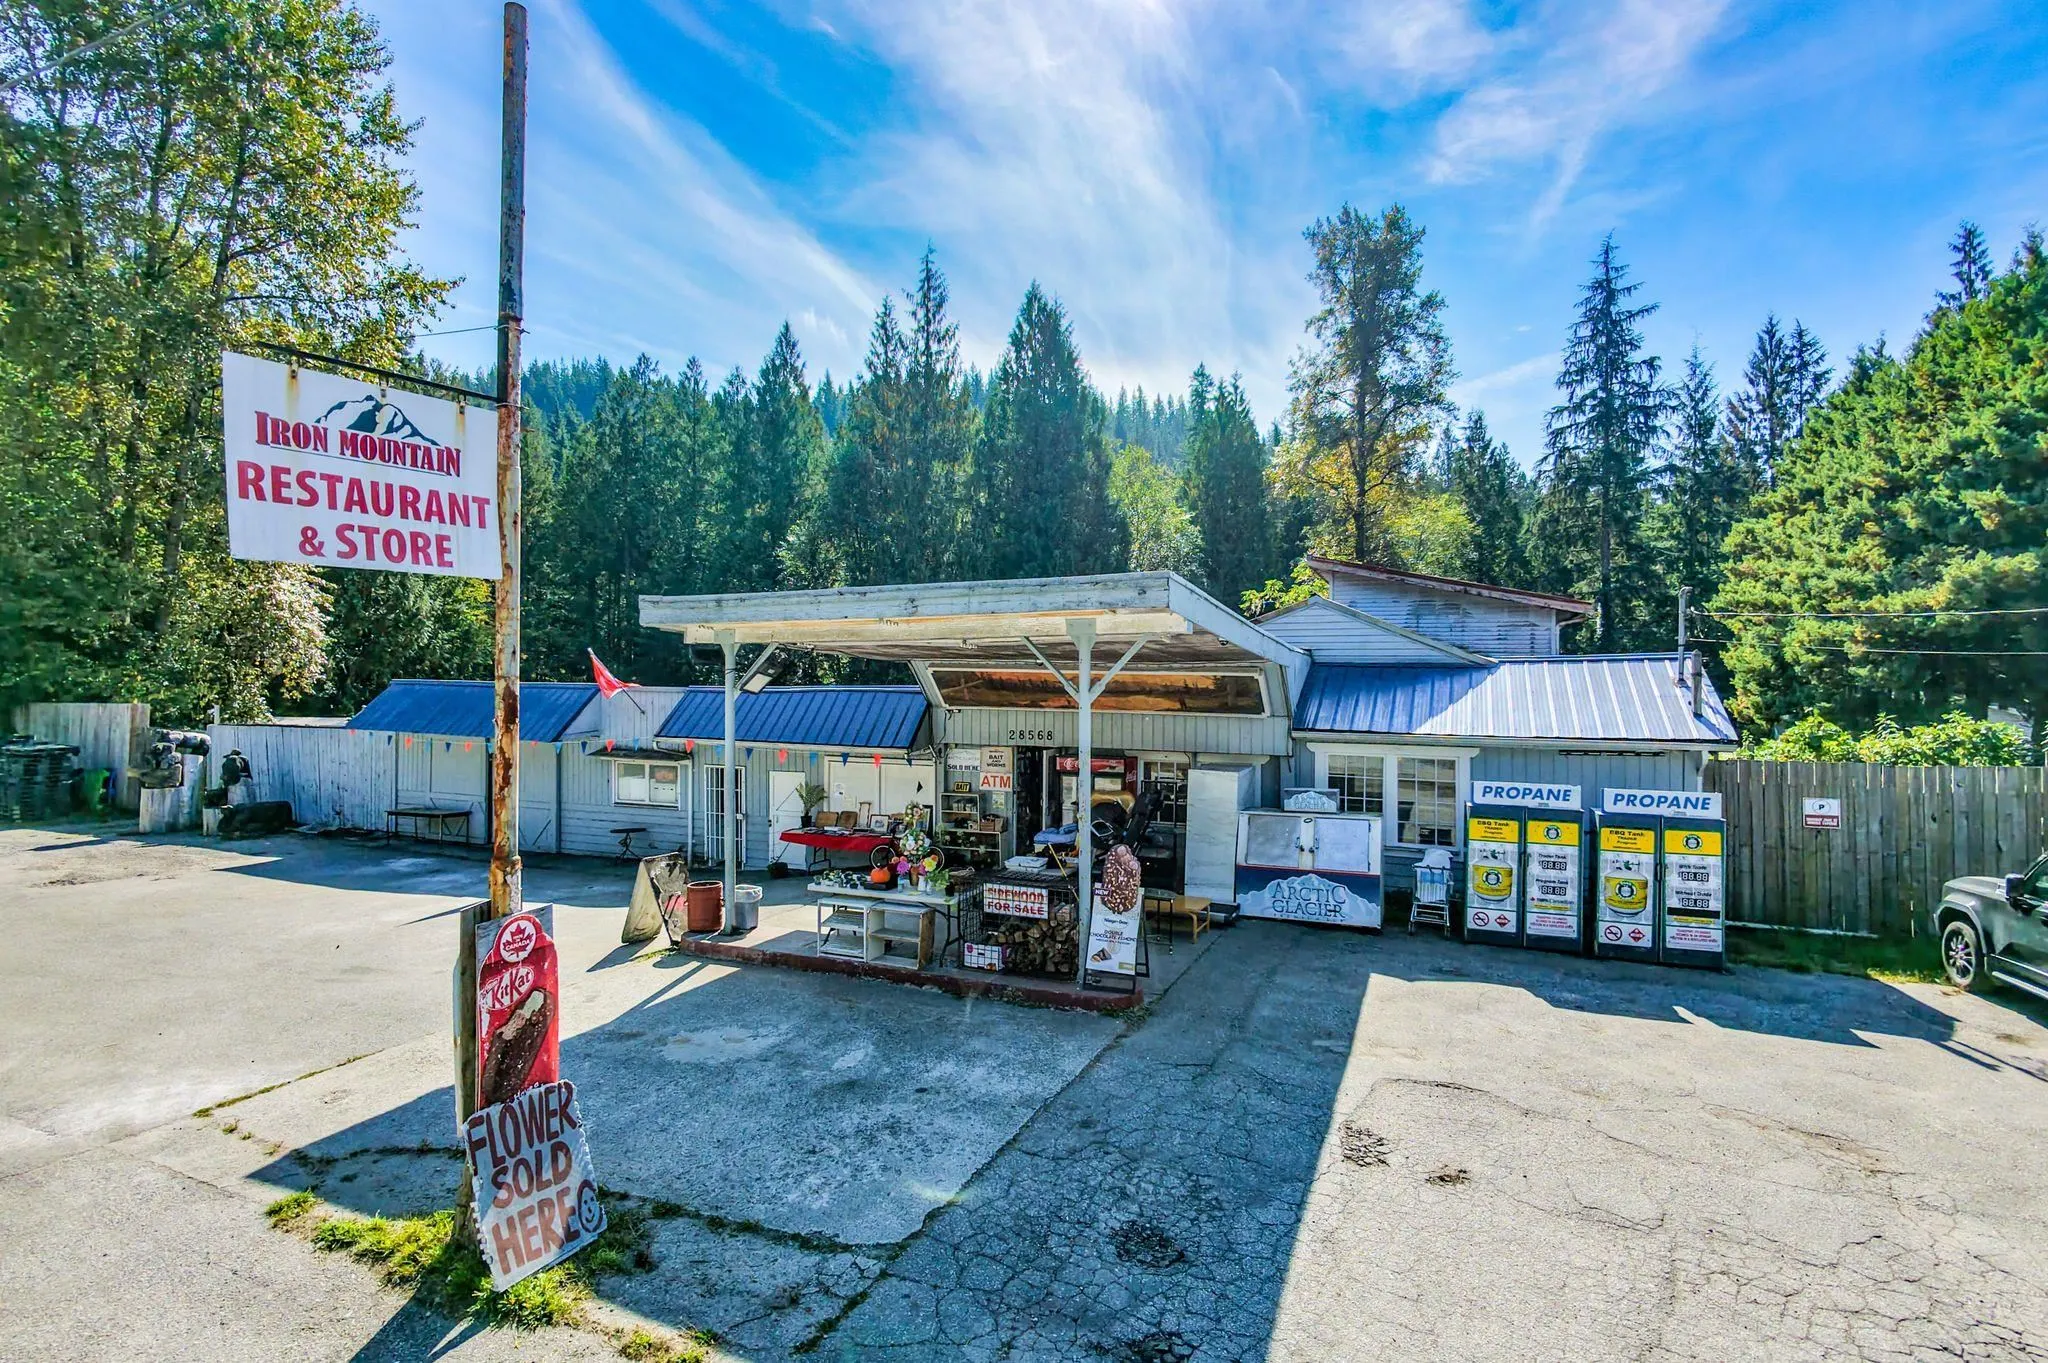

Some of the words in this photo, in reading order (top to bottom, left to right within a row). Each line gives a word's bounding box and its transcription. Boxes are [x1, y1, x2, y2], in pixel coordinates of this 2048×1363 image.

[254, 411, 328, 453] IRON
[338, 429, 462, 477] MOUNTAIN
[236, 460, 491, 529] RESTAURANT
[298, 525, 326, 557] &
[336, 523, 454, 568] STORE
[1008, 729, 1053, 741] 28568
[955, 783, 969, 791] BAIT
[980, 775, 1011, 789] ATM
[1481, 785, 1572, 802] PROPANE
[1612, 793, 1711, 811] PROPANE
[1095, 888, 1109, 896] NEW
[1271, 881, 1346, 905] ARCTIC
[987, 901, 1010, 912] FOR
[1014, 904, 1045, 916] SALE
[1272, 899, 1346, 918] GLACIER
[466, 1081, 578, 1176] FLOWER
[491, 1140, 573, 1209] SOLD
[491, 1187, 581, 1276] HERE
